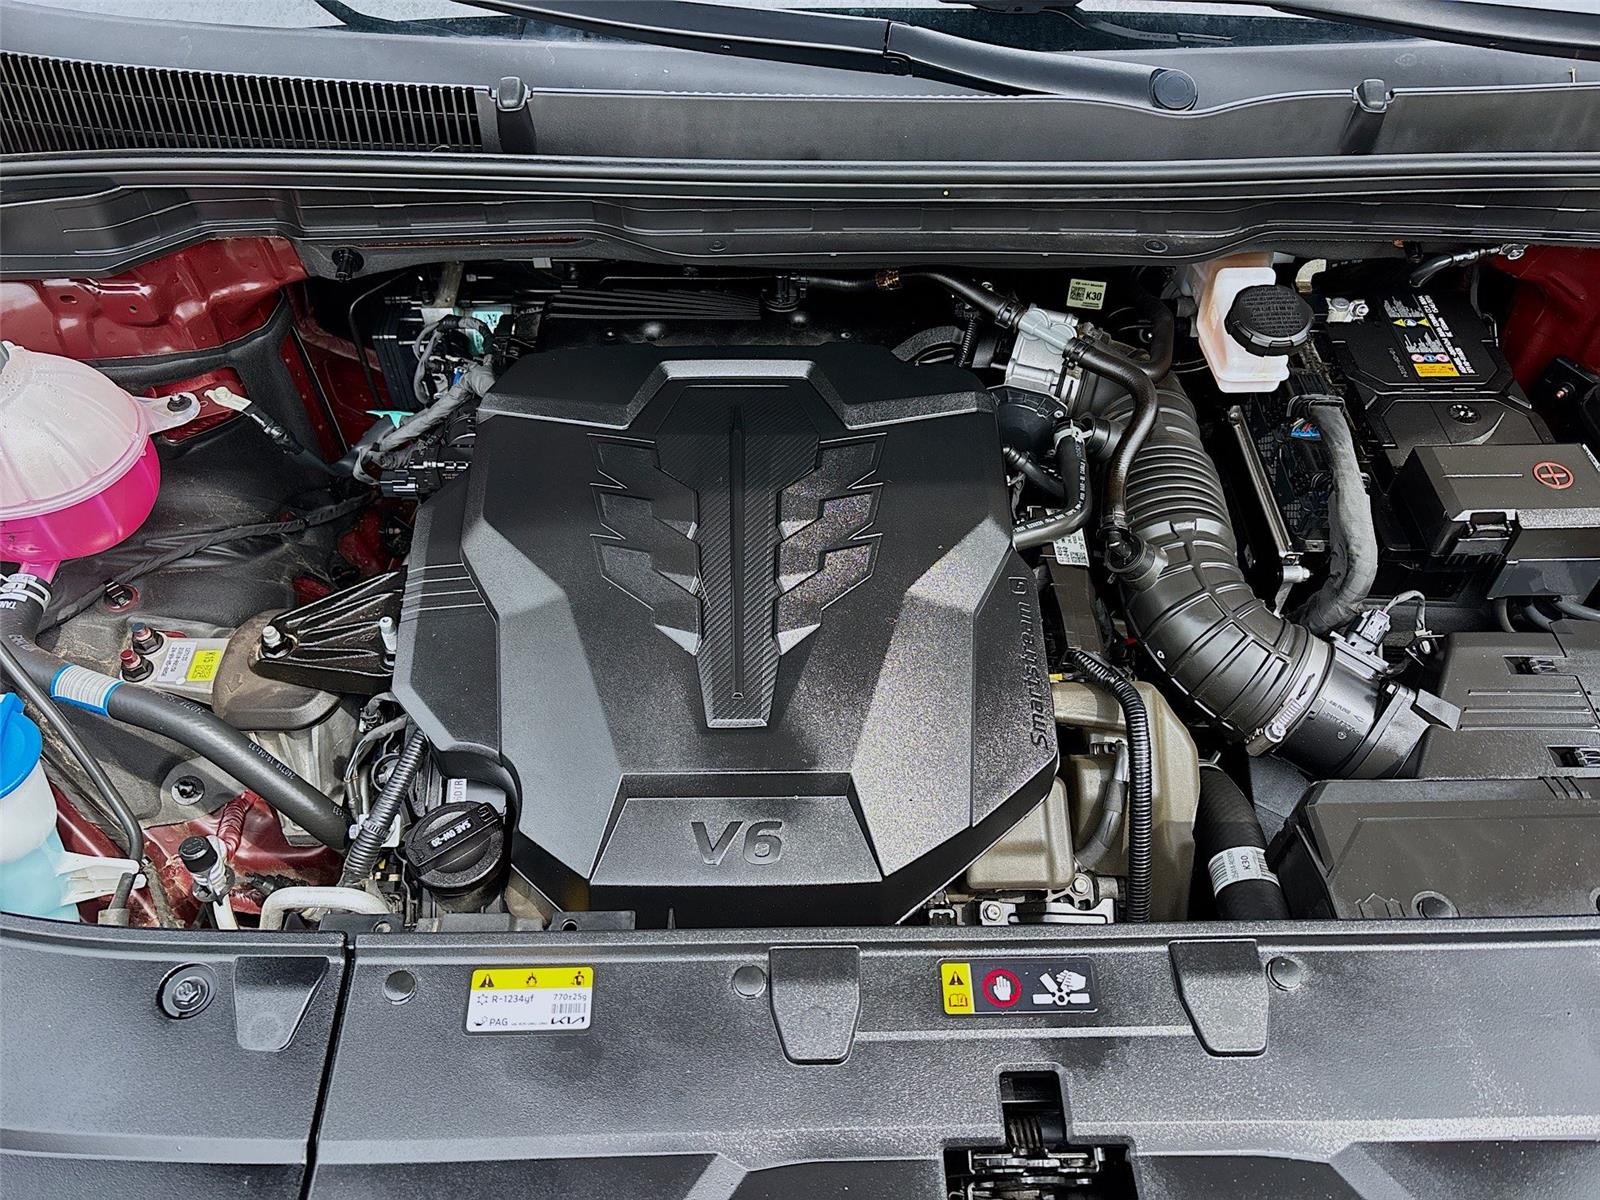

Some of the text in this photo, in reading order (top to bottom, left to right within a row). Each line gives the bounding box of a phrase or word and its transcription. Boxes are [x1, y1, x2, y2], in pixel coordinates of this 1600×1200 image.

[1085, 291, 1103, 301] K30
[1008, 576, 1050, 751] Smartstream G
[431, 820, 472, 848] SAE 0W-20
[690, 820, 783, 865] V6
[1240, 855, 1251, 870] K30
[491, 993, 535, 1005] R-1234yf
[489, 1018, 508, 1027] PAG
[550, 1016, 586, 1025] KIA
